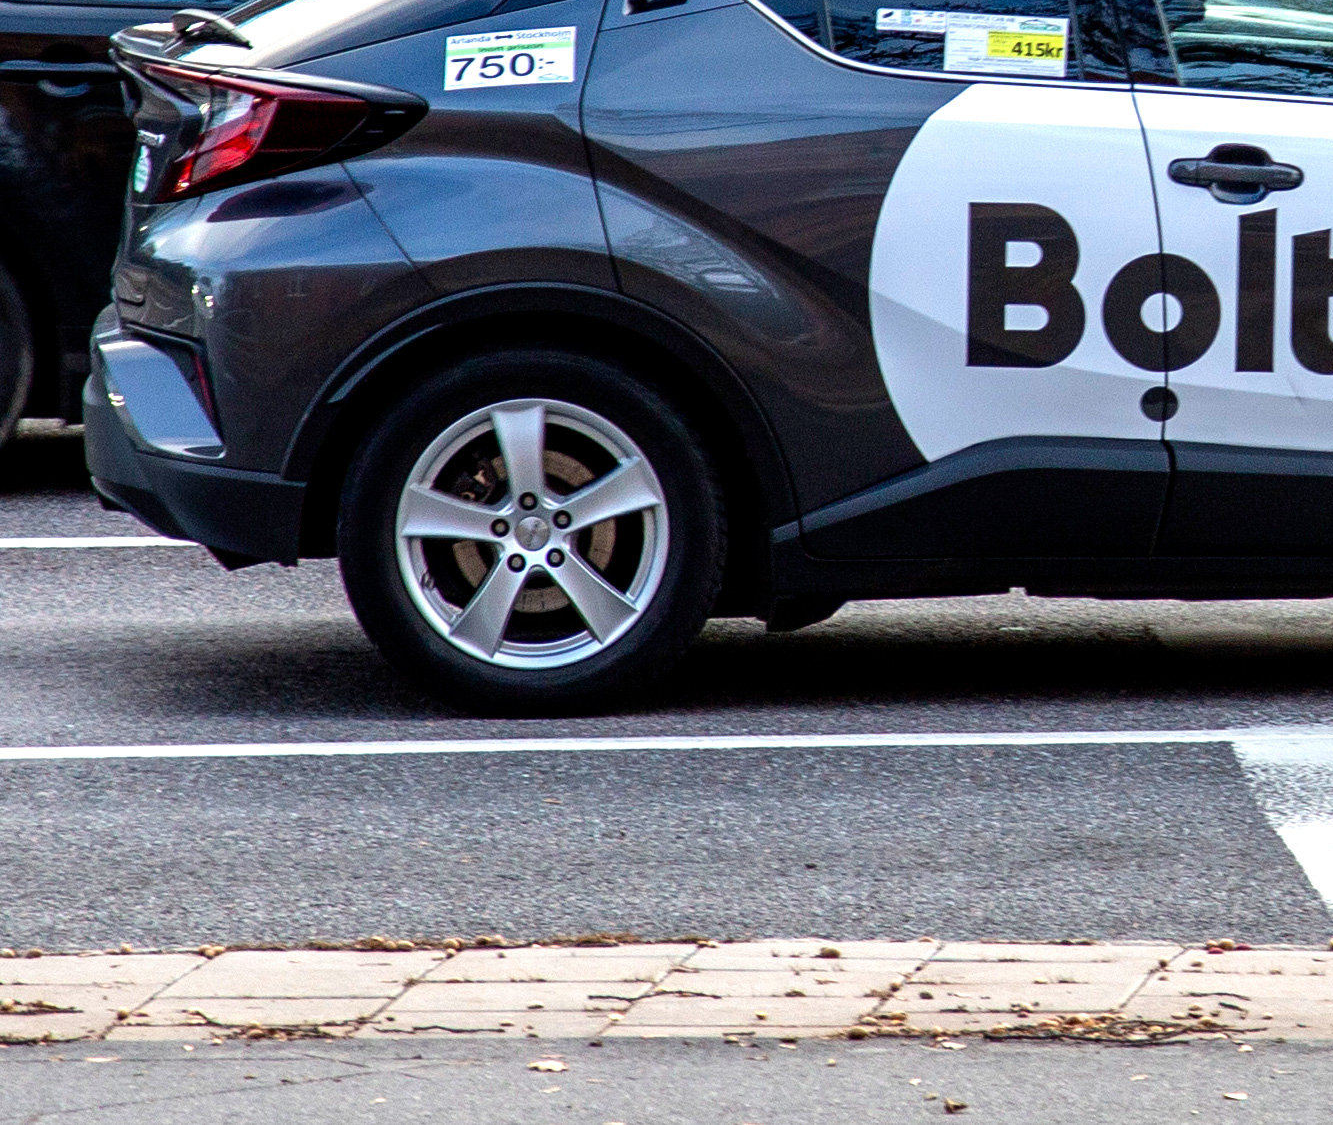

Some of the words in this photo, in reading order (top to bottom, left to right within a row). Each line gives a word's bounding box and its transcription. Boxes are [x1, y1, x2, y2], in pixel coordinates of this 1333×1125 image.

[450, 35, 492, 45] Arlanda
[516, 30, 572, 40] Stockholm
[1011, 41, 1064, 59] 415kr
[450, 53, 555, 81] 750:-
